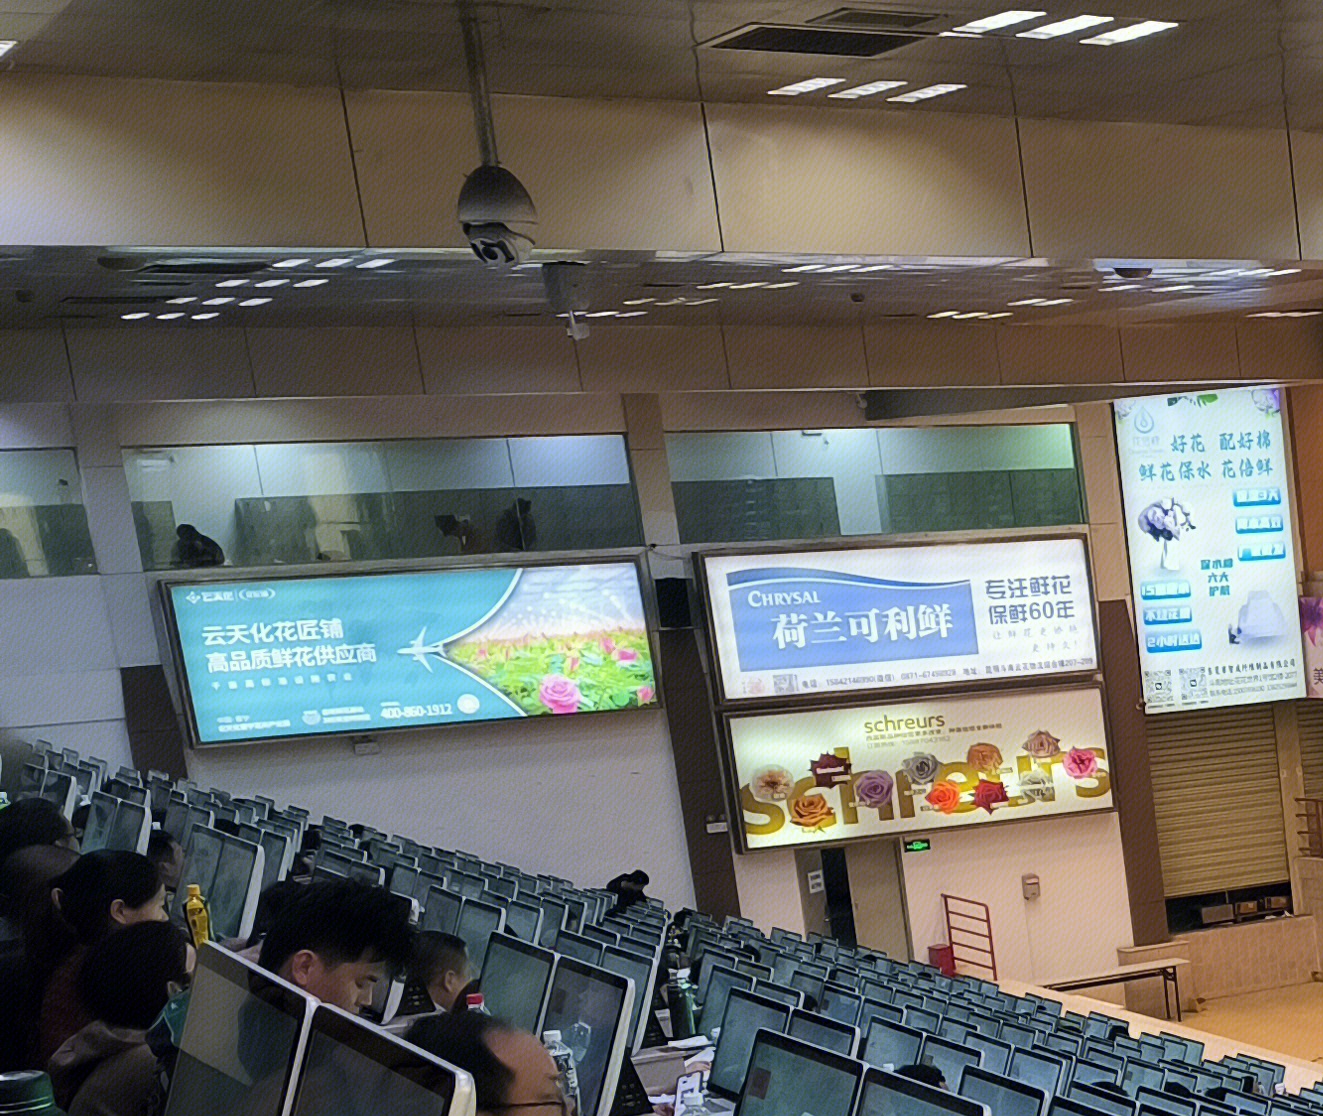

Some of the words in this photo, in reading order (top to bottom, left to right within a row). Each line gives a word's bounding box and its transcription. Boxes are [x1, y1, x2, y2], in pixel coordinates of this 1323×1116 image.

[1170, 433, 1206, 454] 好花
[984, 575, 1072, 600] 专注鲜花
[1208, 572, 1229, 583] 六大
[988, 600, 1075, 625] 保鲜60年
[202, 618, 344, 646] 云天化花匠铺
[770, 603, 953, 650] 荷兰可利鲜
[206, 643, 377, 673] 高品质鲜花供应商
[864, 714, 945, 734] schreurs
